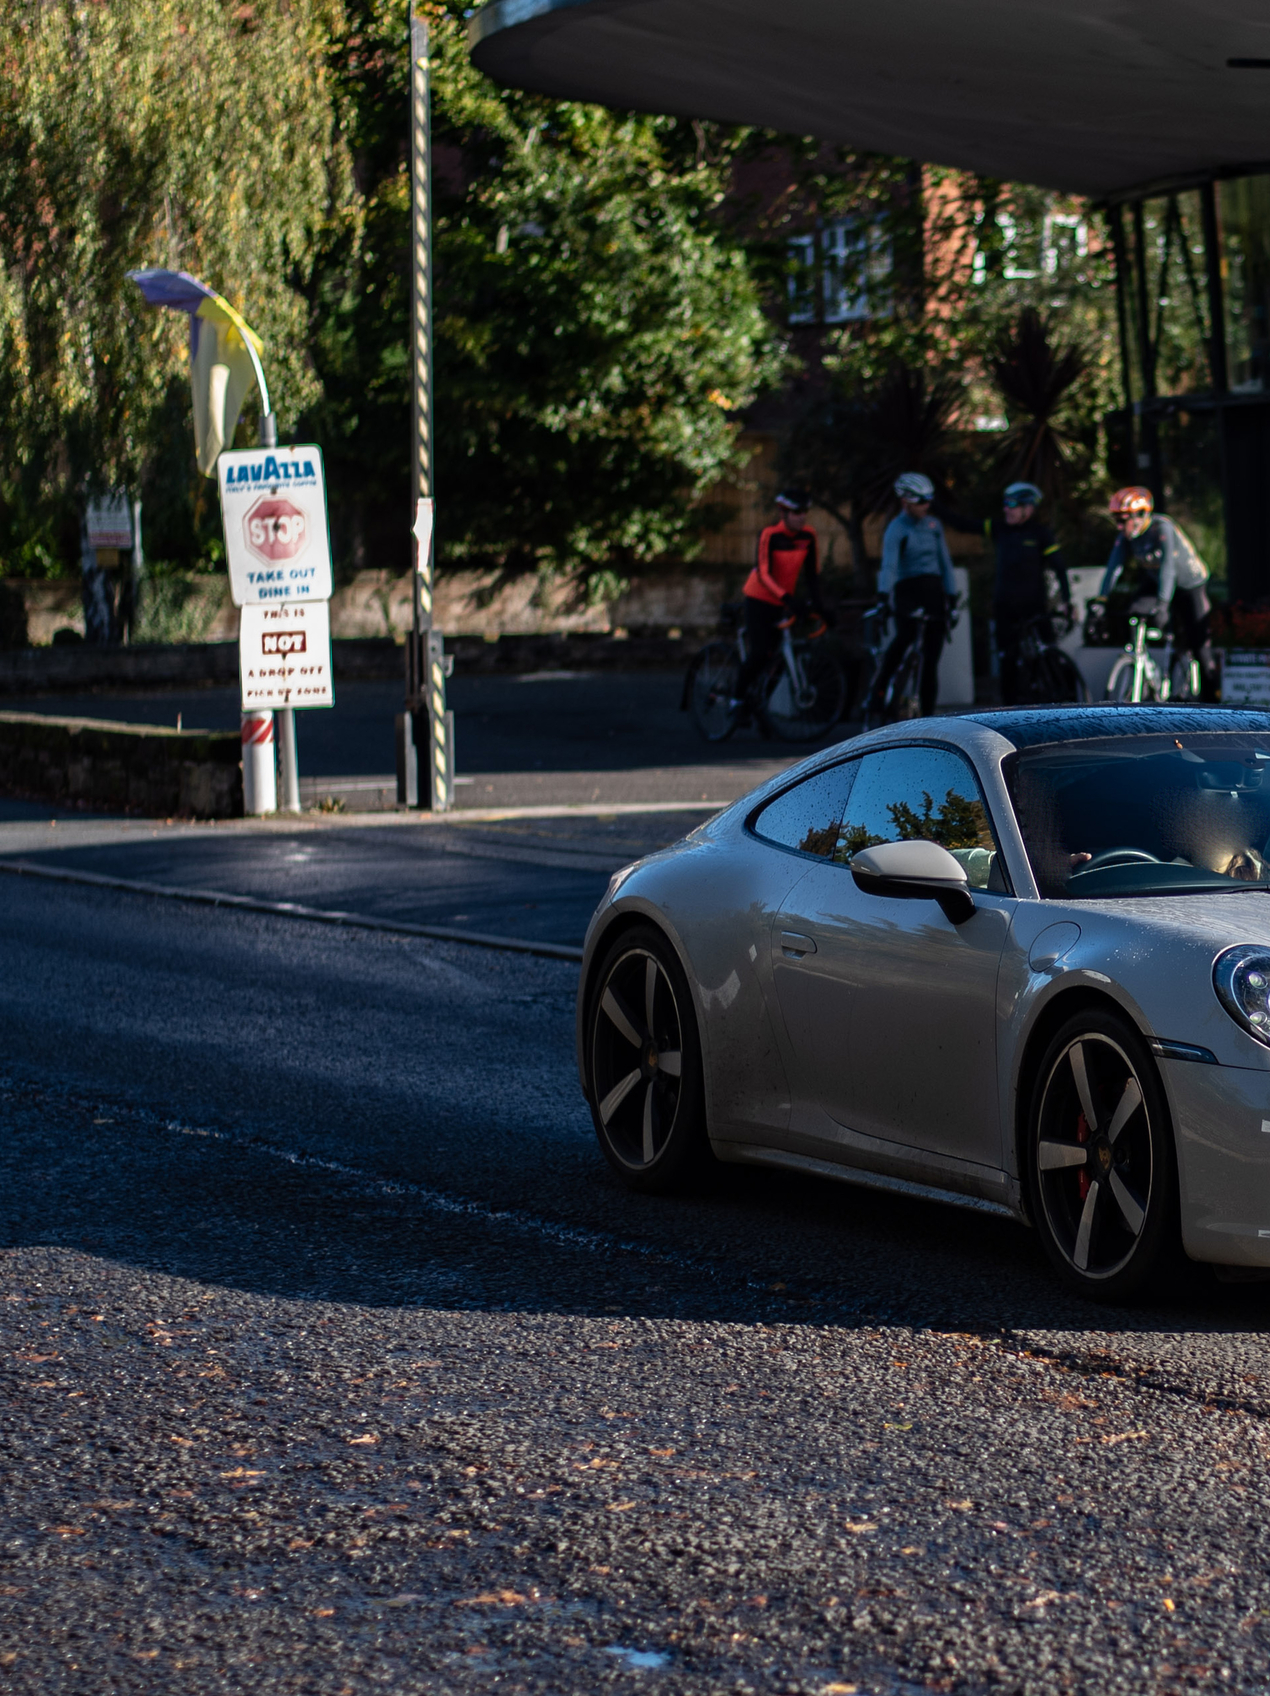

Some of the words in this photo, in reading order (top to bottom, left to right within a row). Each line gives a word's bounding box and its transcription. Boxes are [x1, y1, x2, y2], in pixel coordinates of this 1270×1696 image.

[226, 456, 316, 484] LAVAZZA
[250, 514, 305, 546] STOP
[247, 569, 284, 584] TAKE
[289, 568, 315, 580] OUT
[258, 585, 291, 599] DINE
[297, 585, 310, 594] IN
[264, 609, 289, 619] THIS
[294, 608, 305, 618] IS
[264, 635, 304, 652] NOT
[248, 669, 255, 678] A
[260, 667, 295, 678] DROP
[300, 666, 323, 676] OFF
